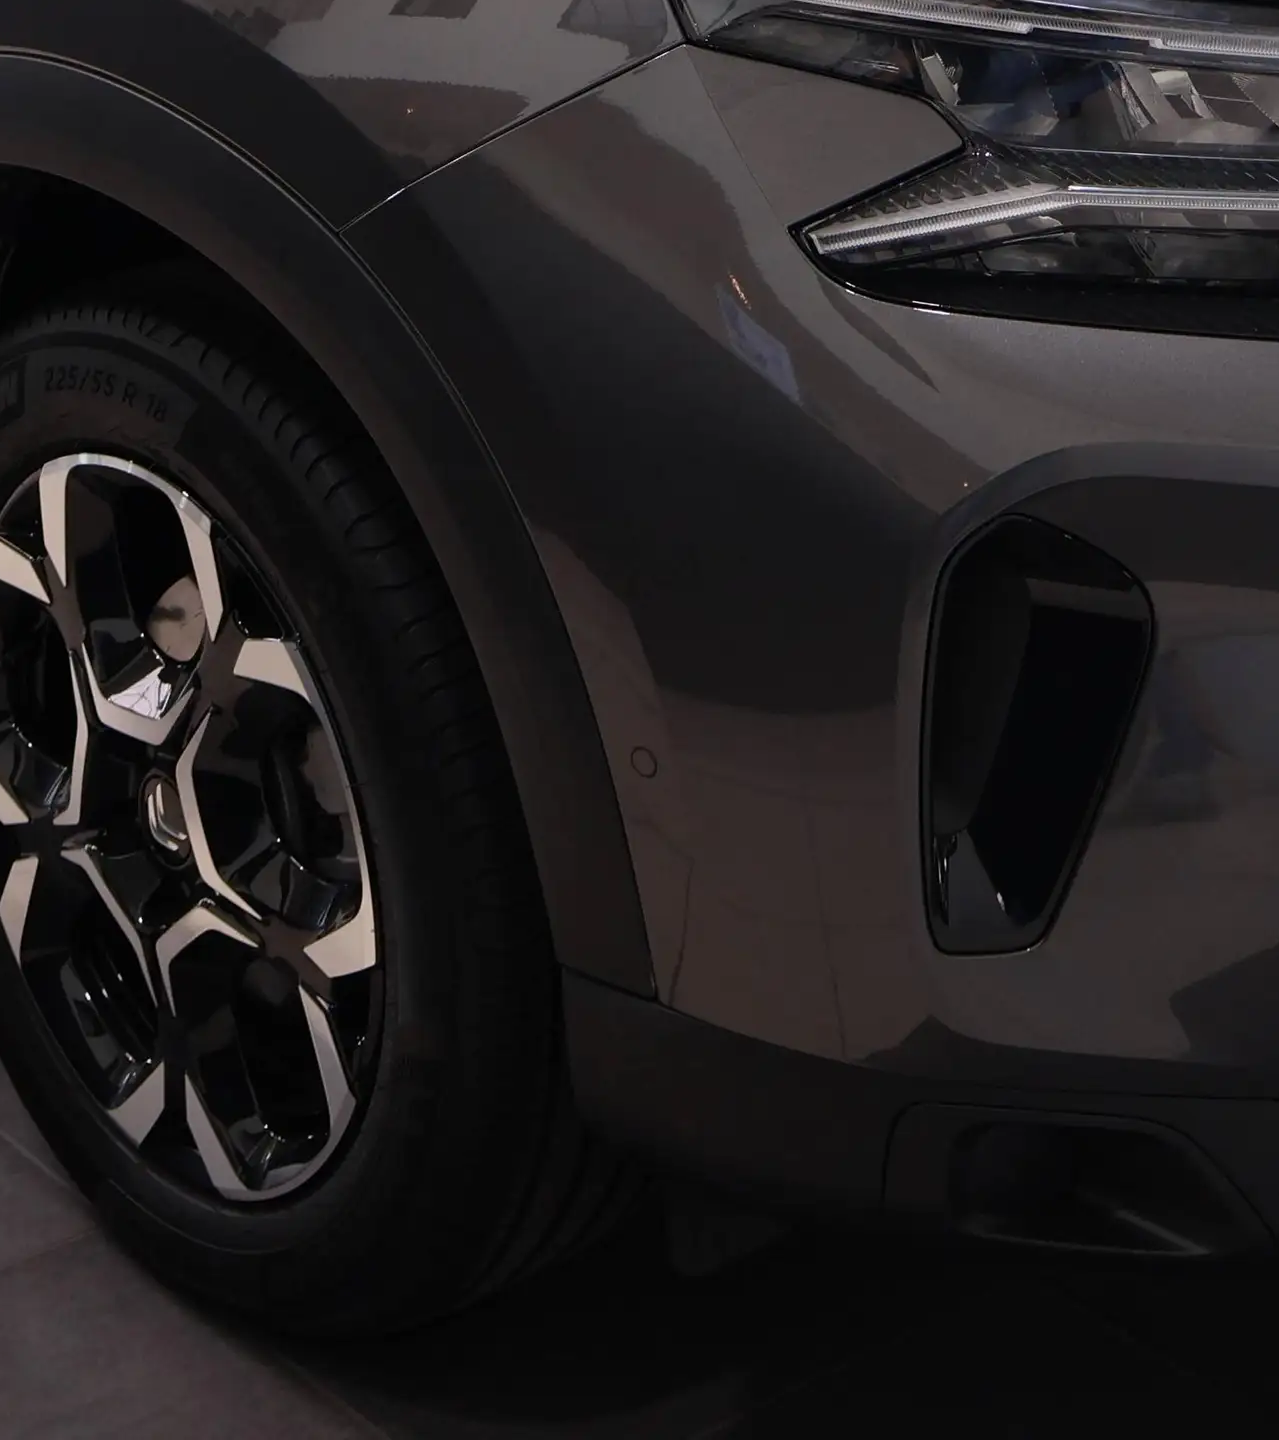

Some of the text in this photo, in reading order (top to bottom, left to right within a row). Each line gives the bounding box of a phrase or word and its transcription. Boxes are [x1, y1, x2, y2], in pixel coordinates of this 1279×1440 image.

[44, 363, 170, 423] 225/55 R 18
